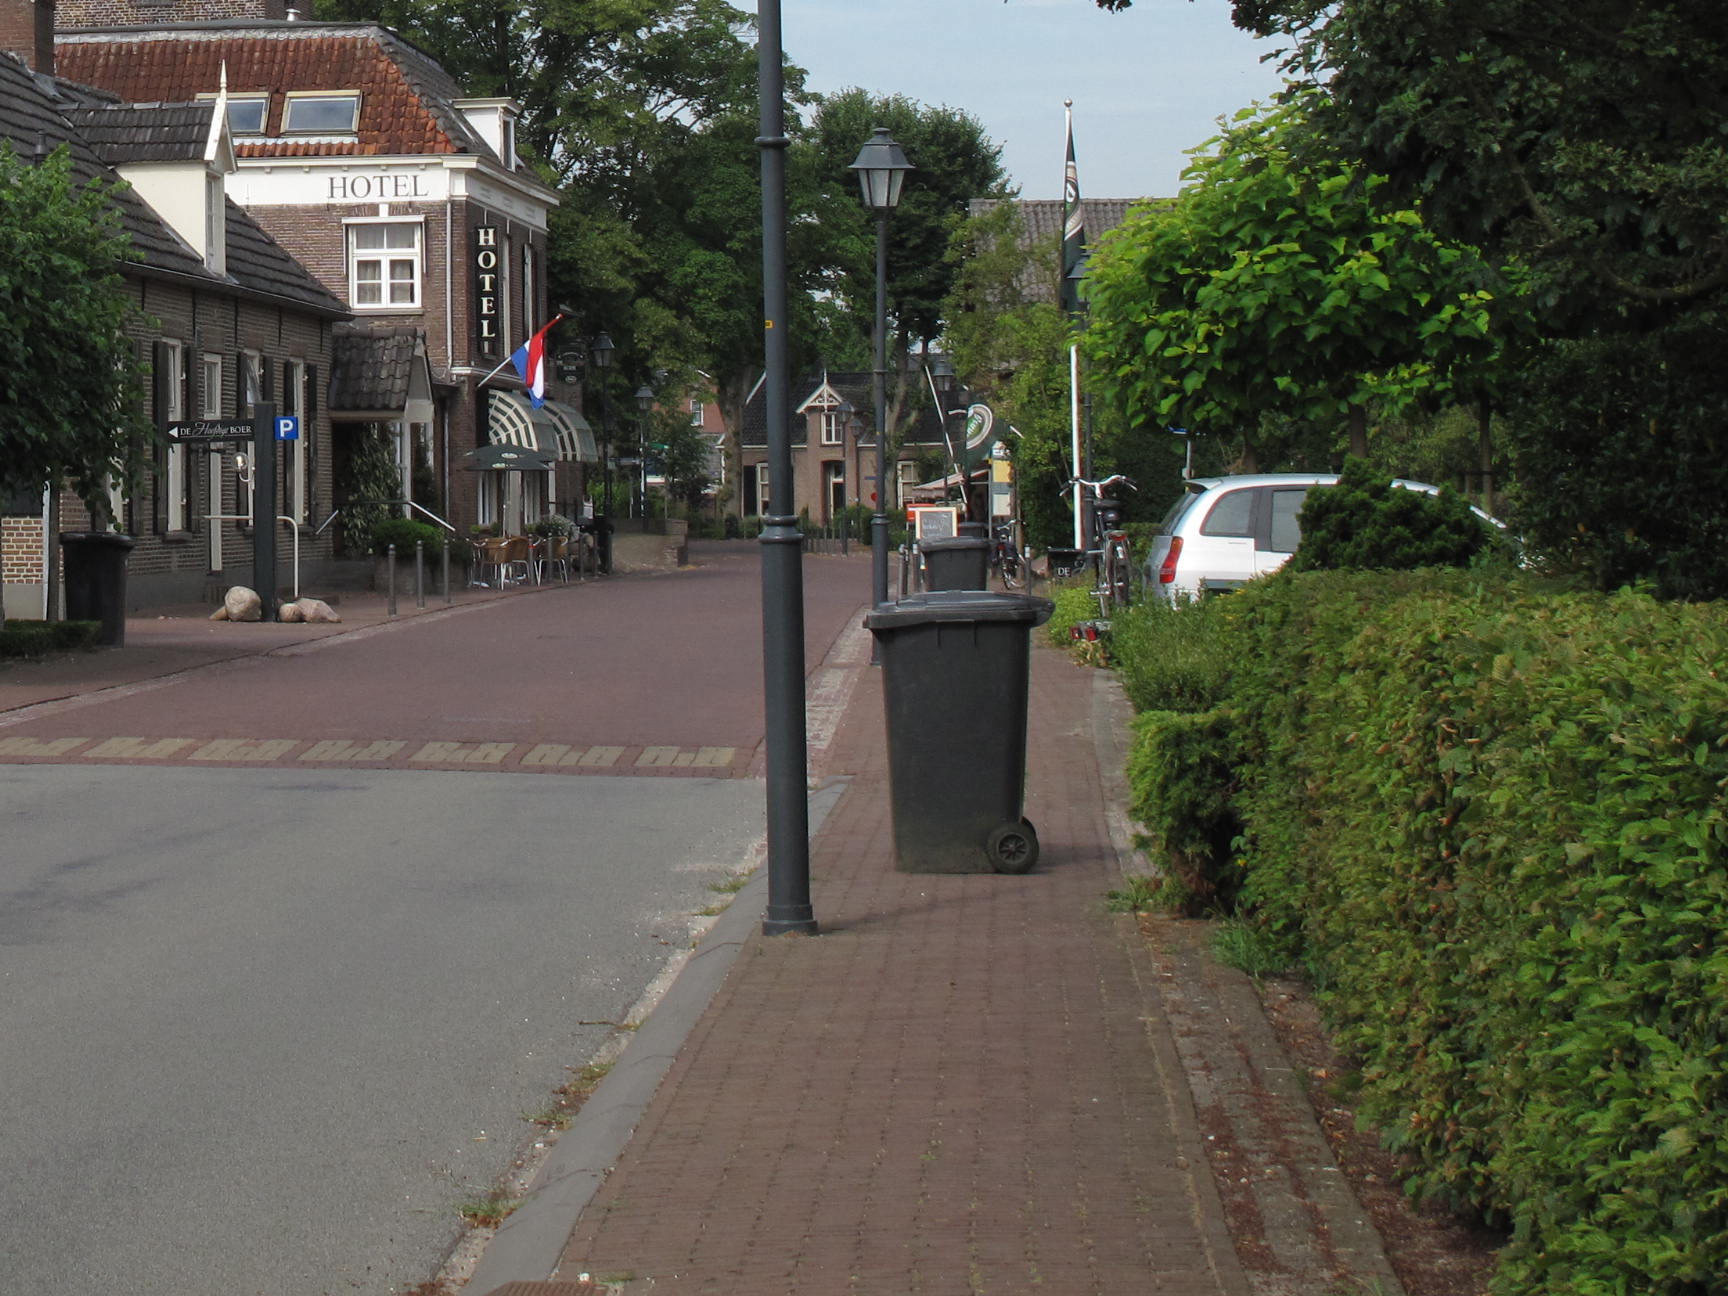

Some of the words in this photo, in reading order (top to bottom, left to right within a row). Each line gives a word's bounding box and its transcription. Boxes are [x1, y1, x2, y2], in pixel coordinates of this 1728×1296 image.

[327, 175, 429, 198] HOTEL
[478, 228, 496, 337] HOTEL
[230, 426, 252, 434] BOER
[280, 419, 293, 437] P
[1057, 567, 1071, 576] DE
